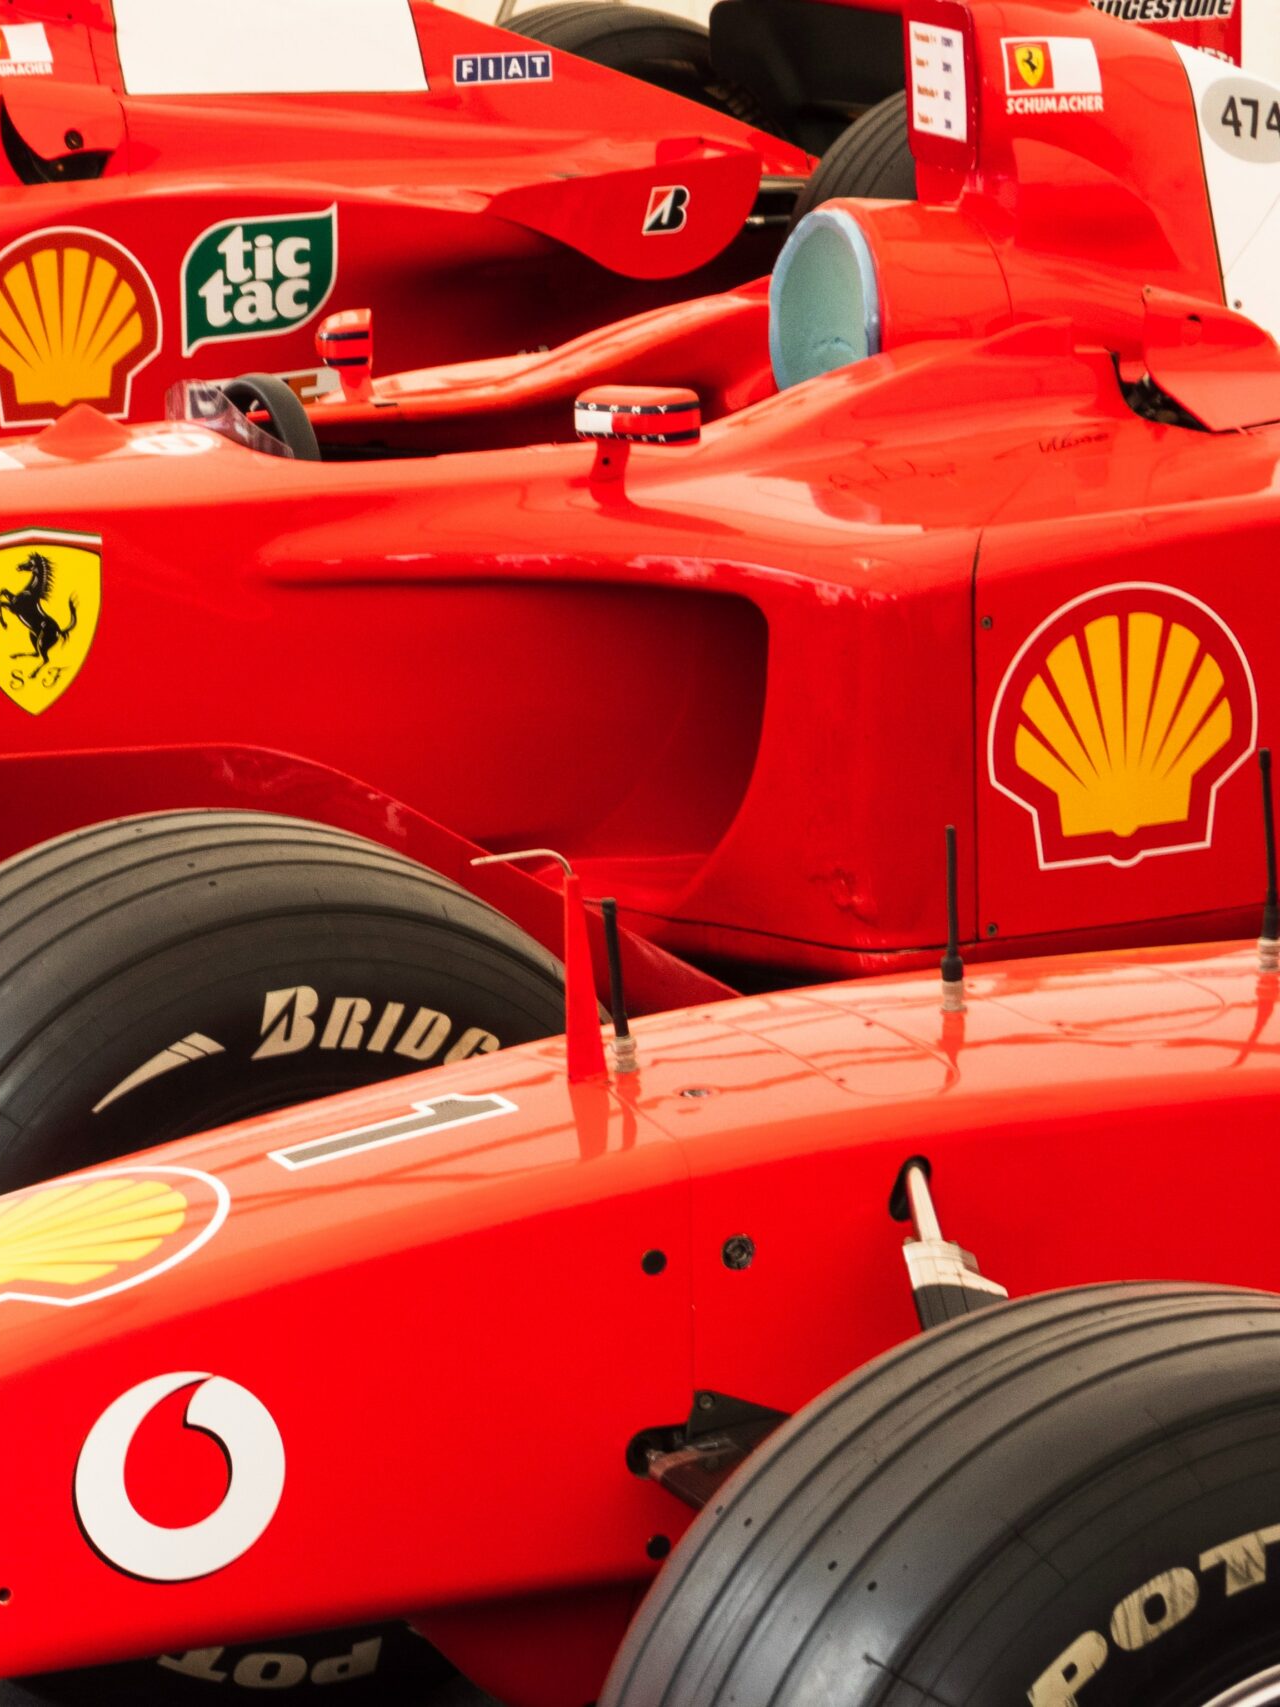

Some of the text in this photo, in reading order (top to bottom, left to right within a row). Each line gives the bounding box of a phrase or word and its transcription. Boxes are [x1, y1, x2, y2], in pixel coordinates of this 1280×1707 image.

[461, 56, 546, 80] FIAT
[1006, 95, 1104, 114] SCHUMACHER
[217, 225, 311, 284] tic
[198, 270, 311, 327] tac
[9, 668, 25, 691] S
[1026, 1522, 1280, 1707] POT
[157, 1635, 382, 1689] POT
